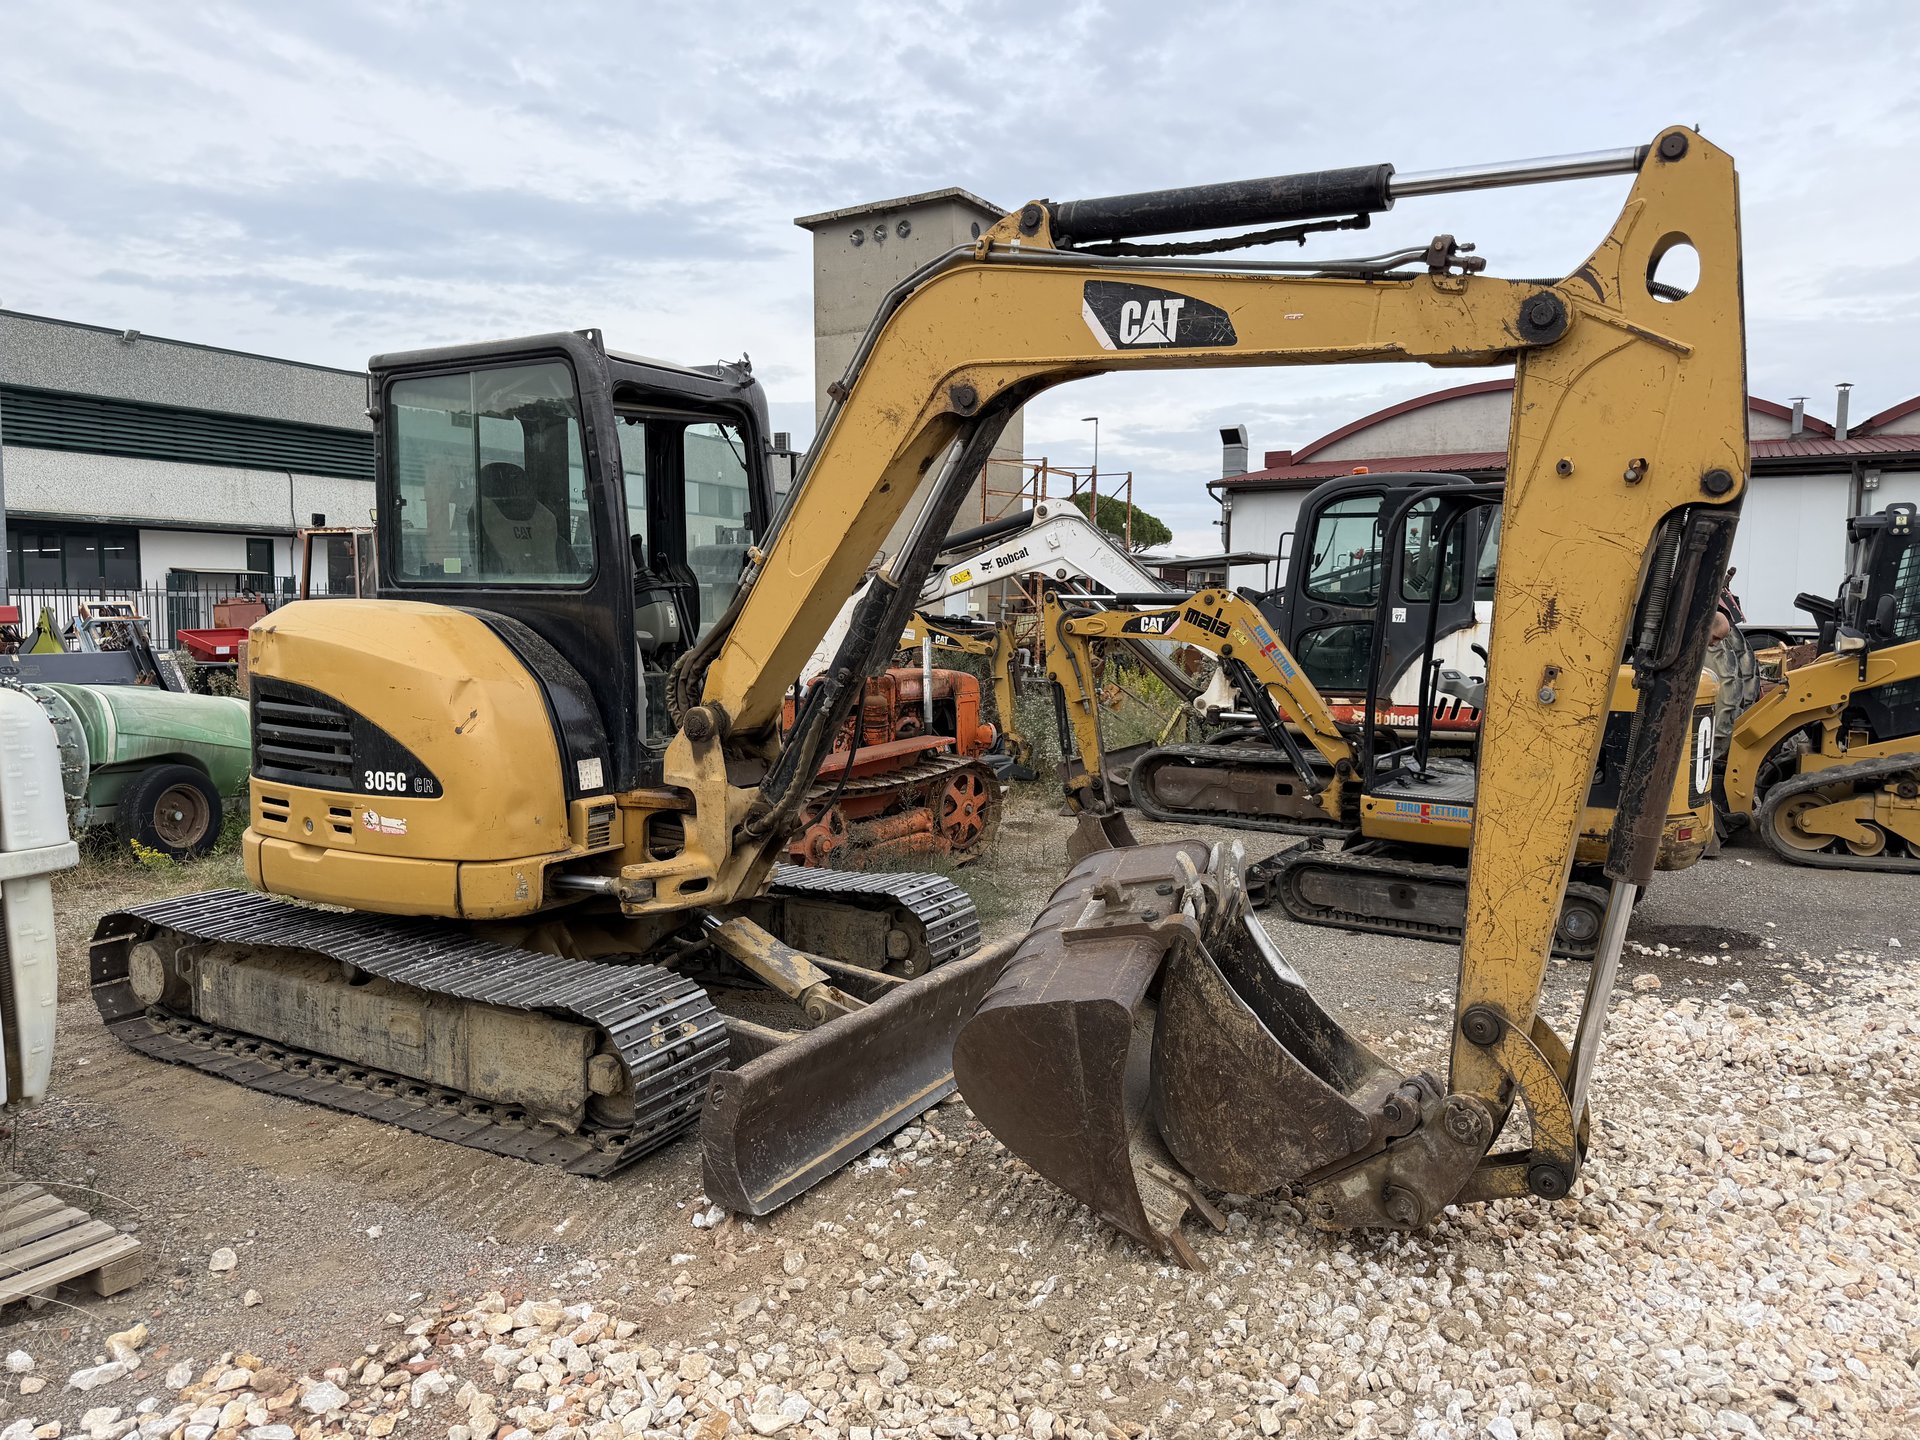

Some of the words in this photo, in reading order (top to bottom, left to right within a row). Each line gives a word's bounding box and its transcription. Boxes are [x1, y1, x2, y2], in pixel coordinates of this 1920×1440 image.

[1119, 298, 1185, 344] CAT
[513, 526, 533, 540] CAT
[995, 546, 1030, 568] Bobcat
[1140, 617, 1165, 633] CAT
[935, 634, 949, 645] CAT
[1375, 712, 1419, 727] Bobcat
[364, 770, 407, 792] 305C
[413, 777, 434, 793] CR
